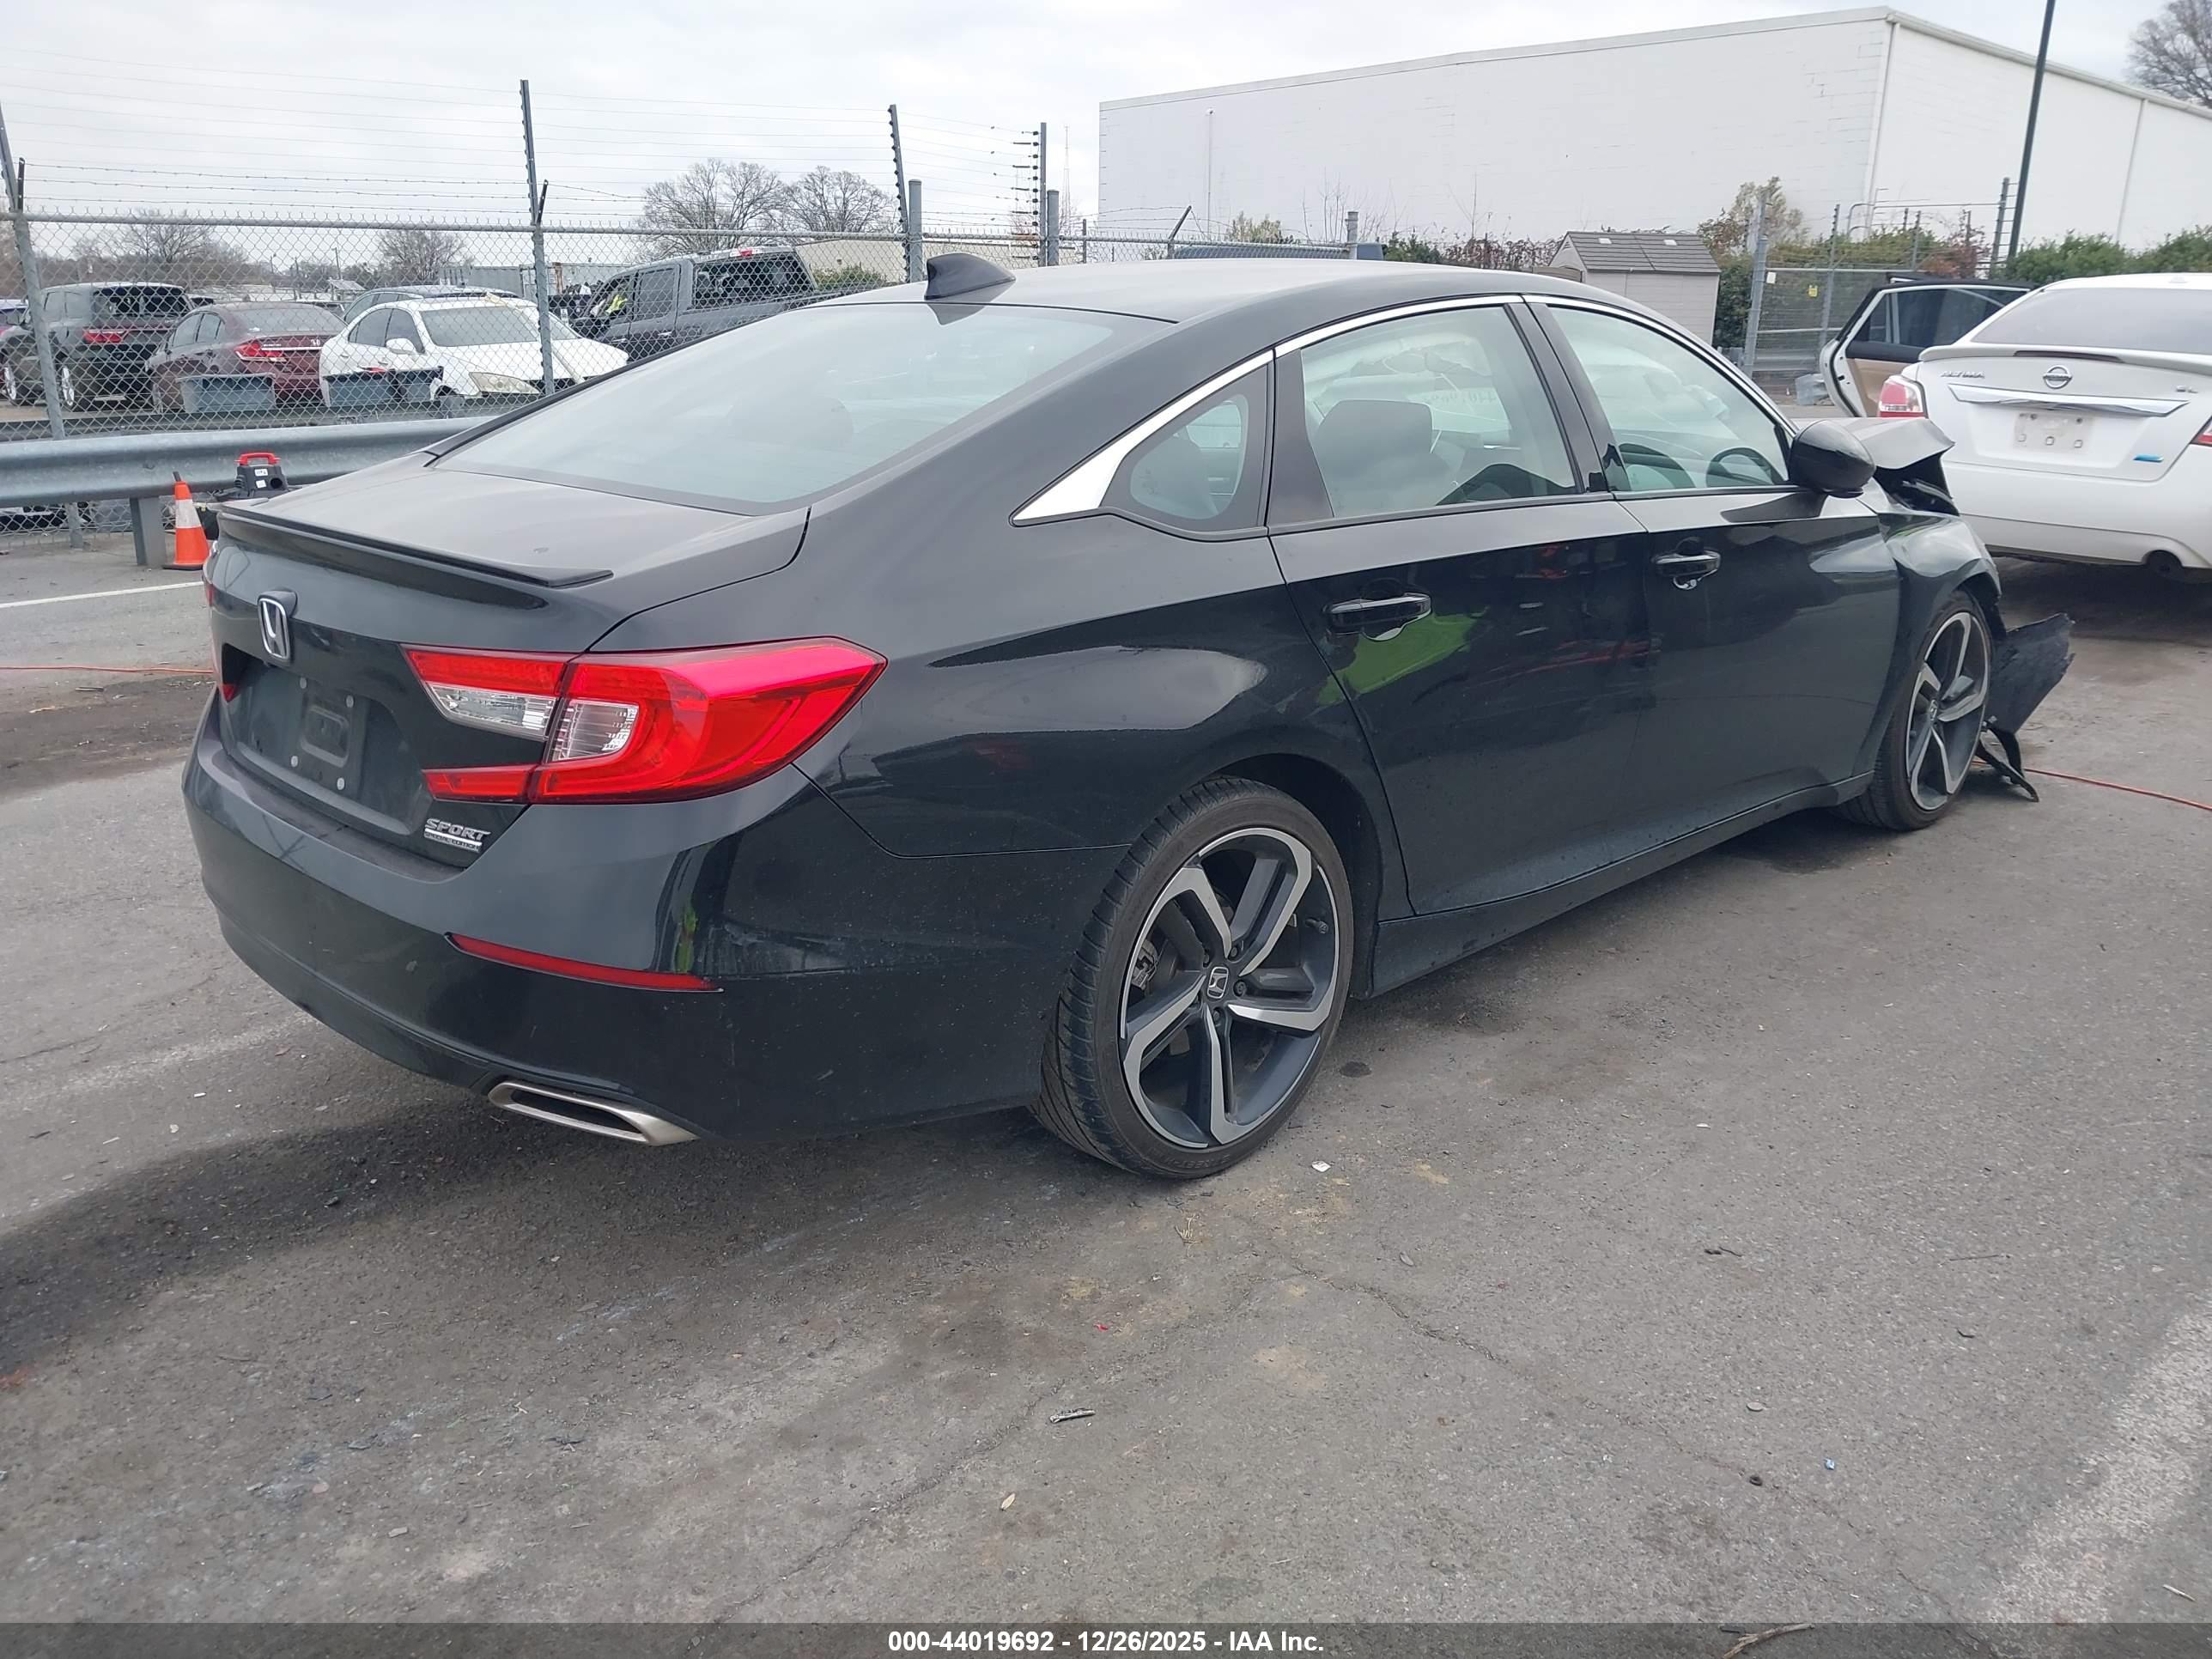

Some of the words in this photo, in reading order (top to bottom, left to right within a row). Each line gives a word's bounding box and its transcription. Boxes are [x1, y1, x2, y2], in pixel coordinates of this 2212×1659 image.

[1939, 370, 1985, 379] ALTIMA
[424, 817, 491, 842] SPORT
[451, 838, 480, 851] EDITION
